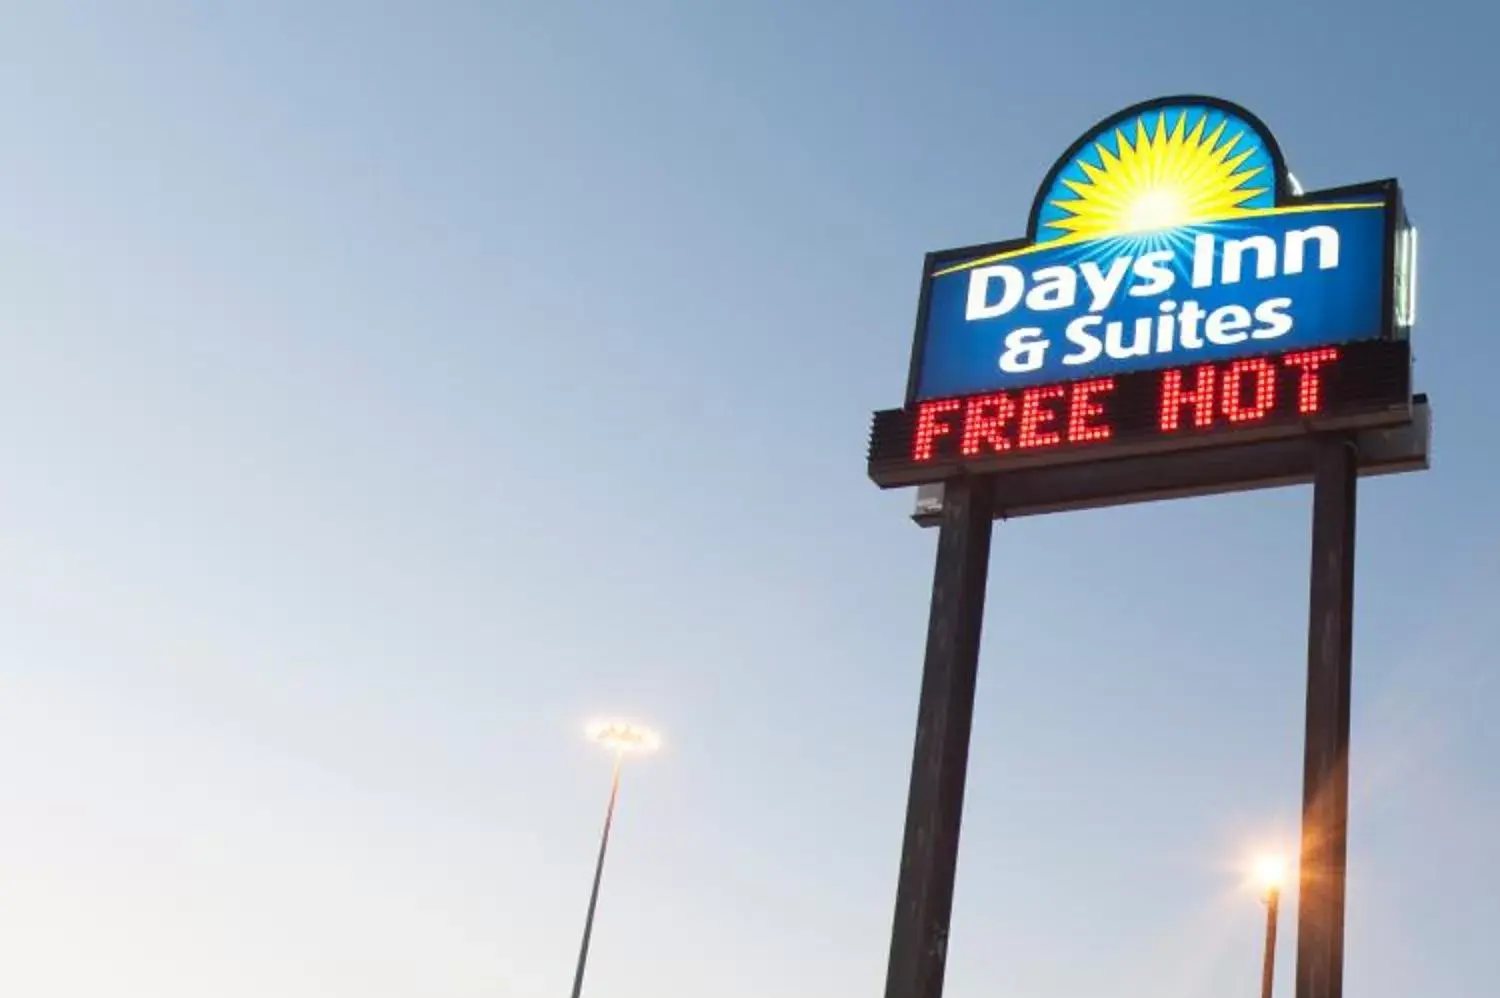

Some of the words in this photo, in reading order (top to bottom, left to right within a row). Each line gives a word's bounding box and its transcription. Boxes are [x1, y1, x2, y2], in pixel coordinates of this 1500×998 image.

[965, 246, 1175, 321] Days
[1191, 223, 1340, 289] Inn
[999, 326, 1050, 373] &
[1062, 296, 1294, 365] Suites
[912, 377, 1116, 461] FREE
[1160, 346, 1344, 431] HOT
